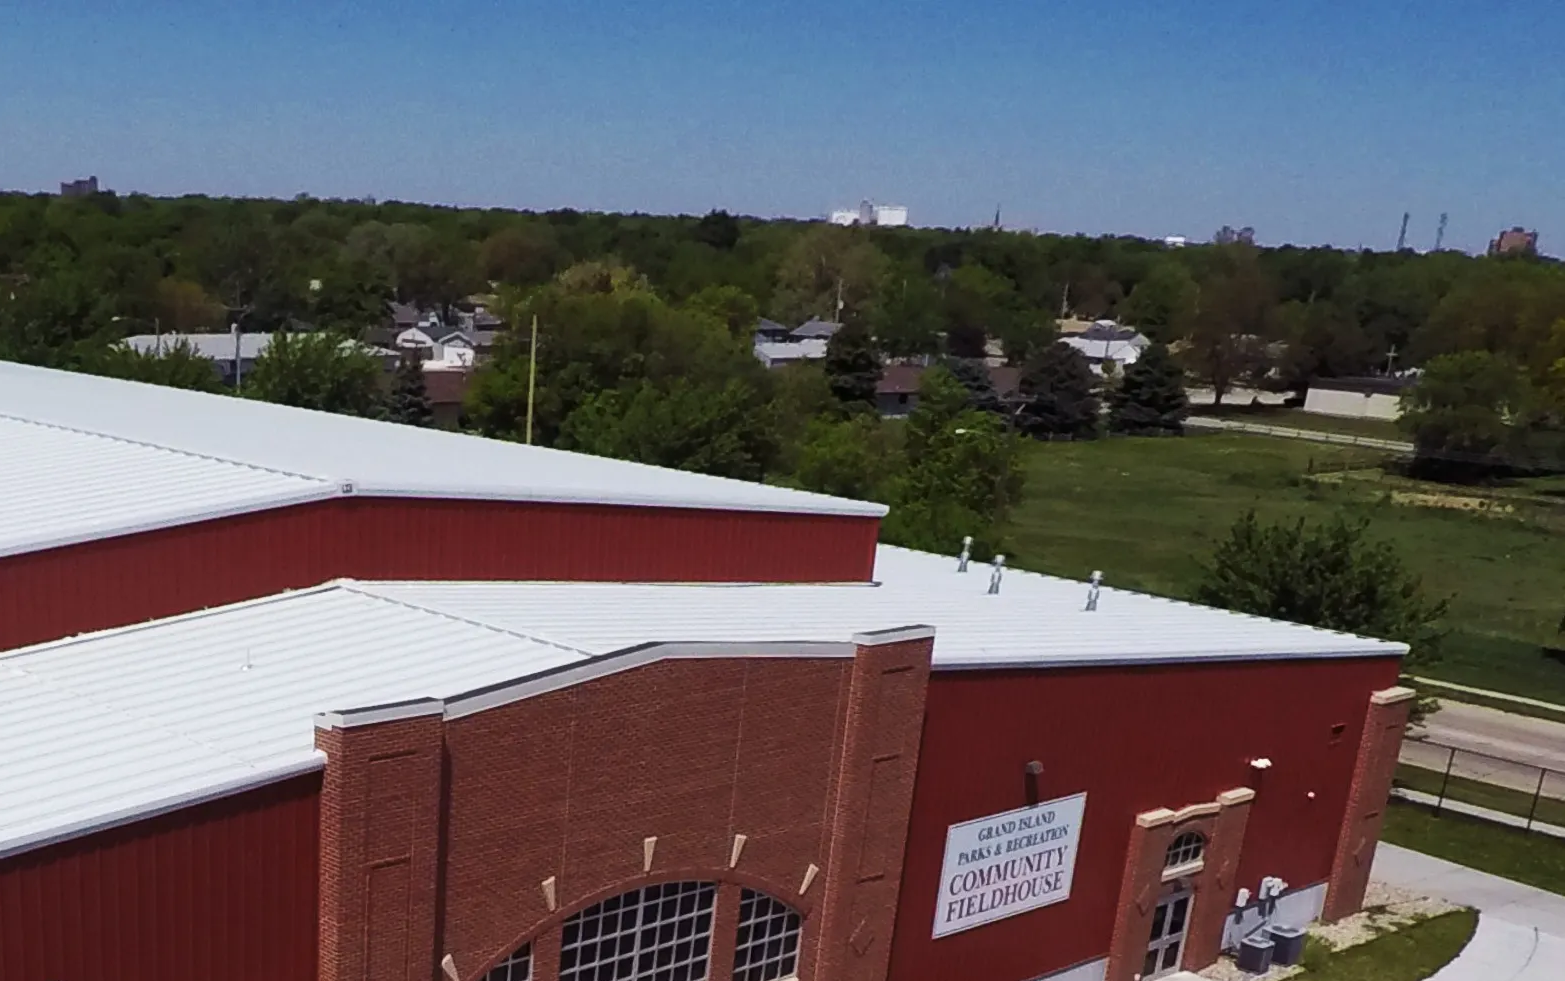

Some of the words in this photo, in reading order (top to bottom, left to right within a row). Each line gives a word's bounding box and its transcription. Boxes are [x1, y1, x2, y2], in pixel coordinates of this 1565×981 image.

[957, 846, 992, 866] PARKS
[994, 843, 1002, 857] &
[1006, 824, 1070, 853] RECREATION
[978, 820, 1016, 842] GRAND
[1018, 811, 1056, 831] ISLAND
[949, 844, 1069, 896] COMMUNITY
[945, 870, 1065, 923] FIELDHOUSE
